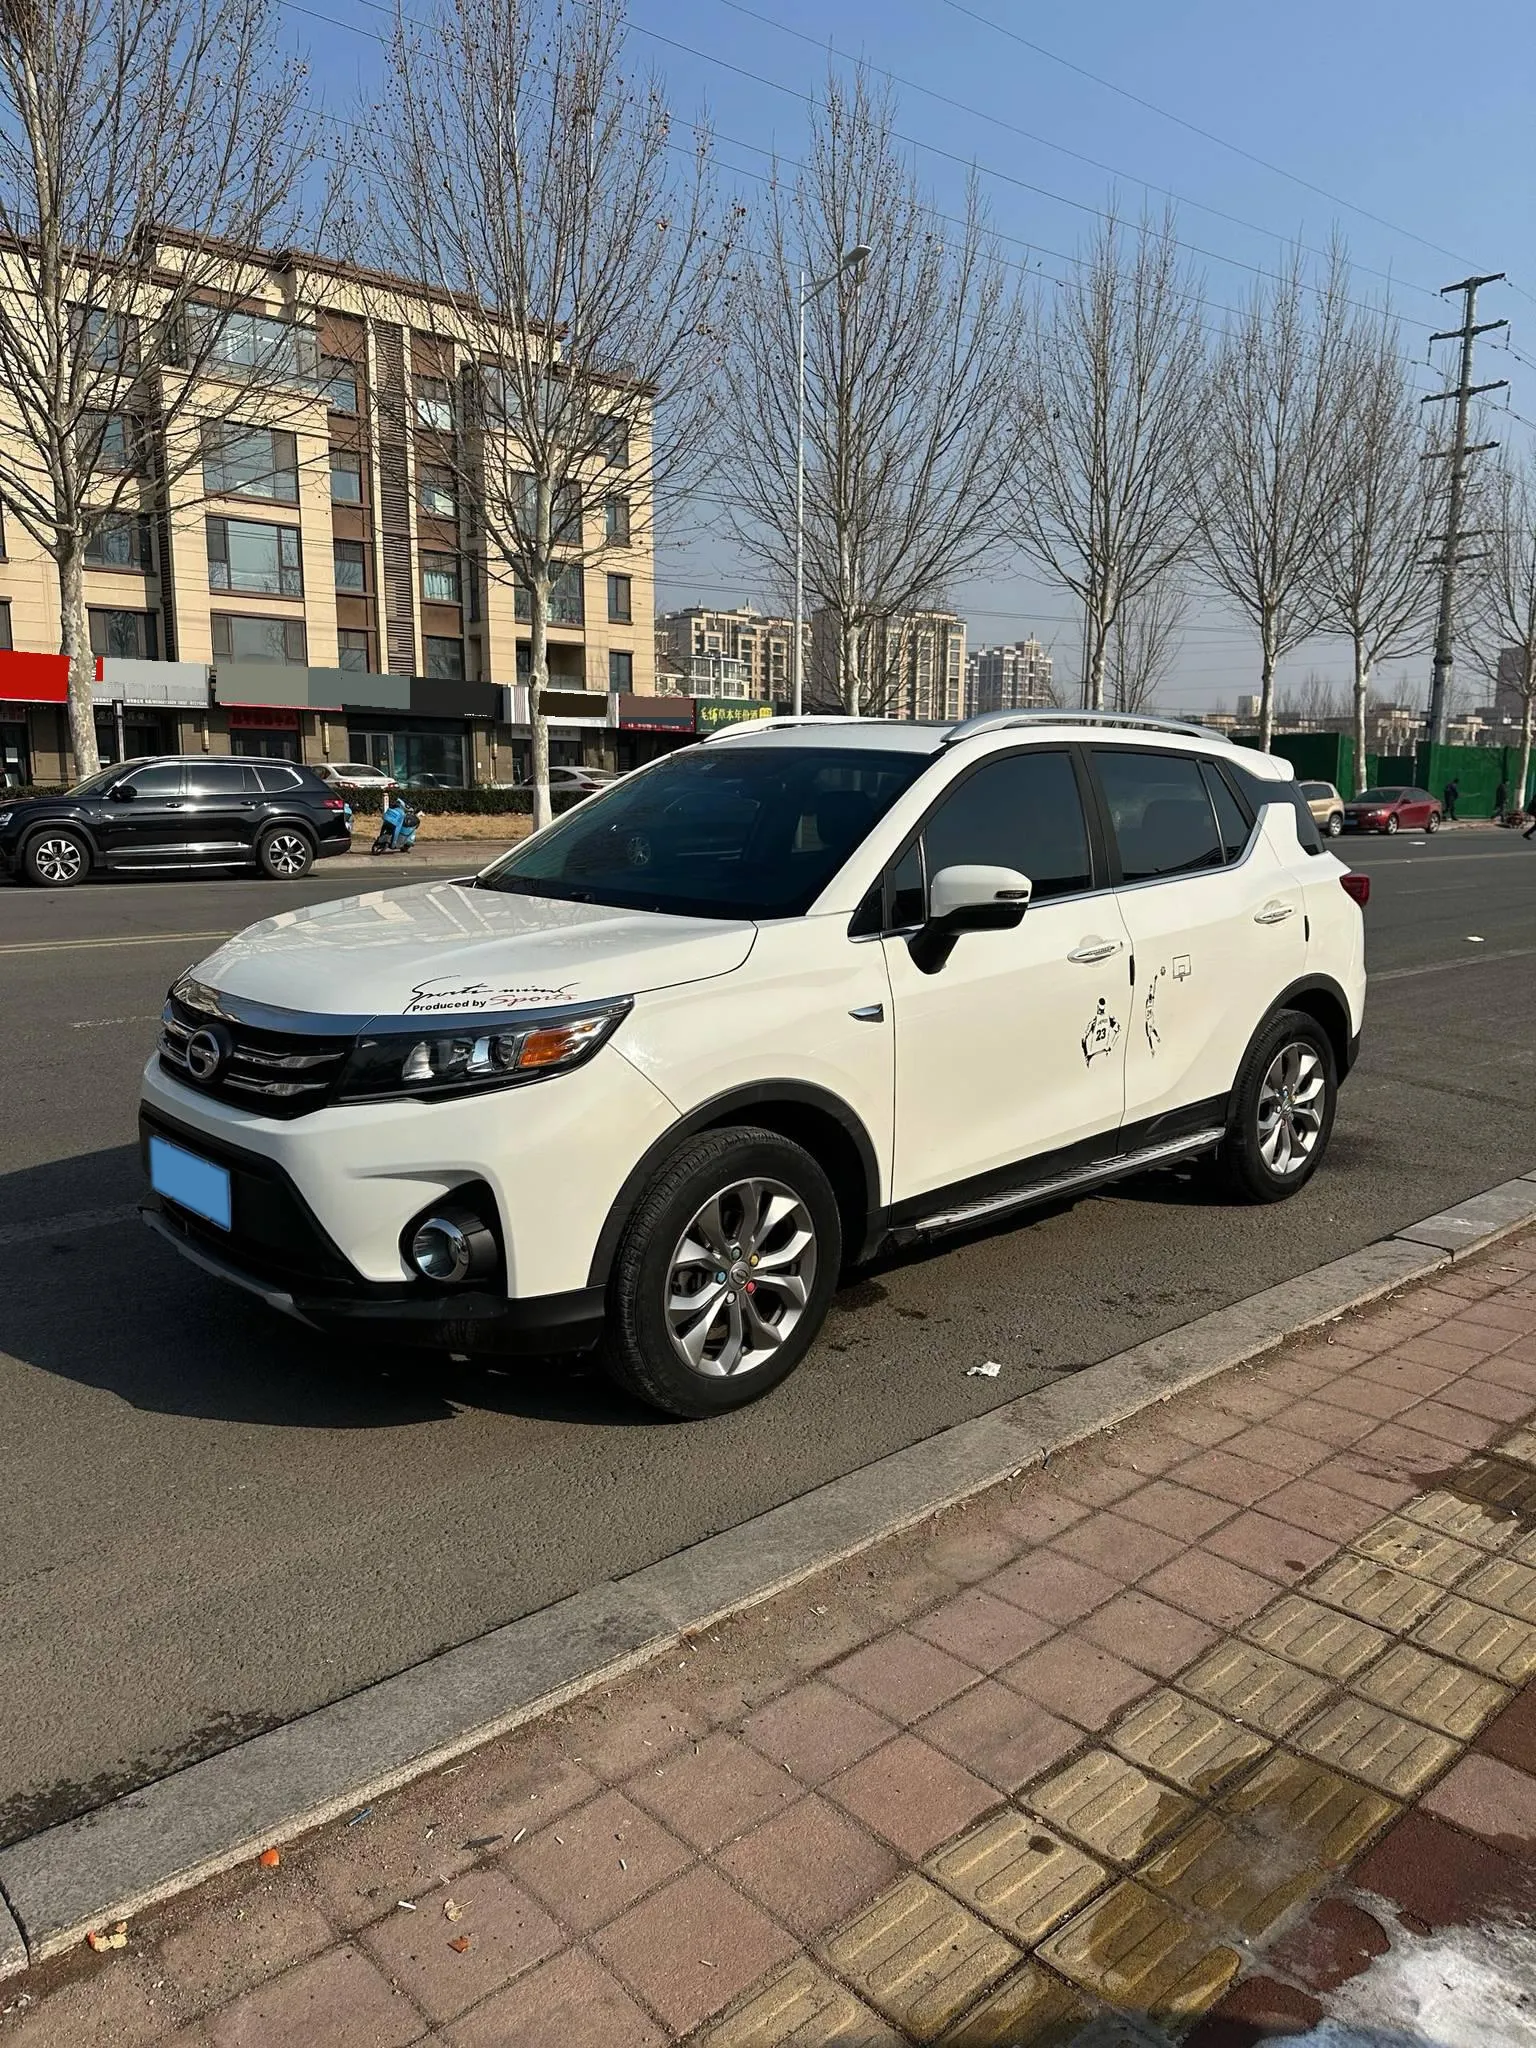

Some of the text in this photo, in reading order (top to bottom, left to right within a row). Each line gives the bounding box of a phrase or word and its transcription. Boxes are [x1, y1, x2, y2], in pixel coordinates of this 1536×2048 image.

[412, 994, 579, 1012] Produced by Sports
[1096, 1028, 1107, 1041] 23
